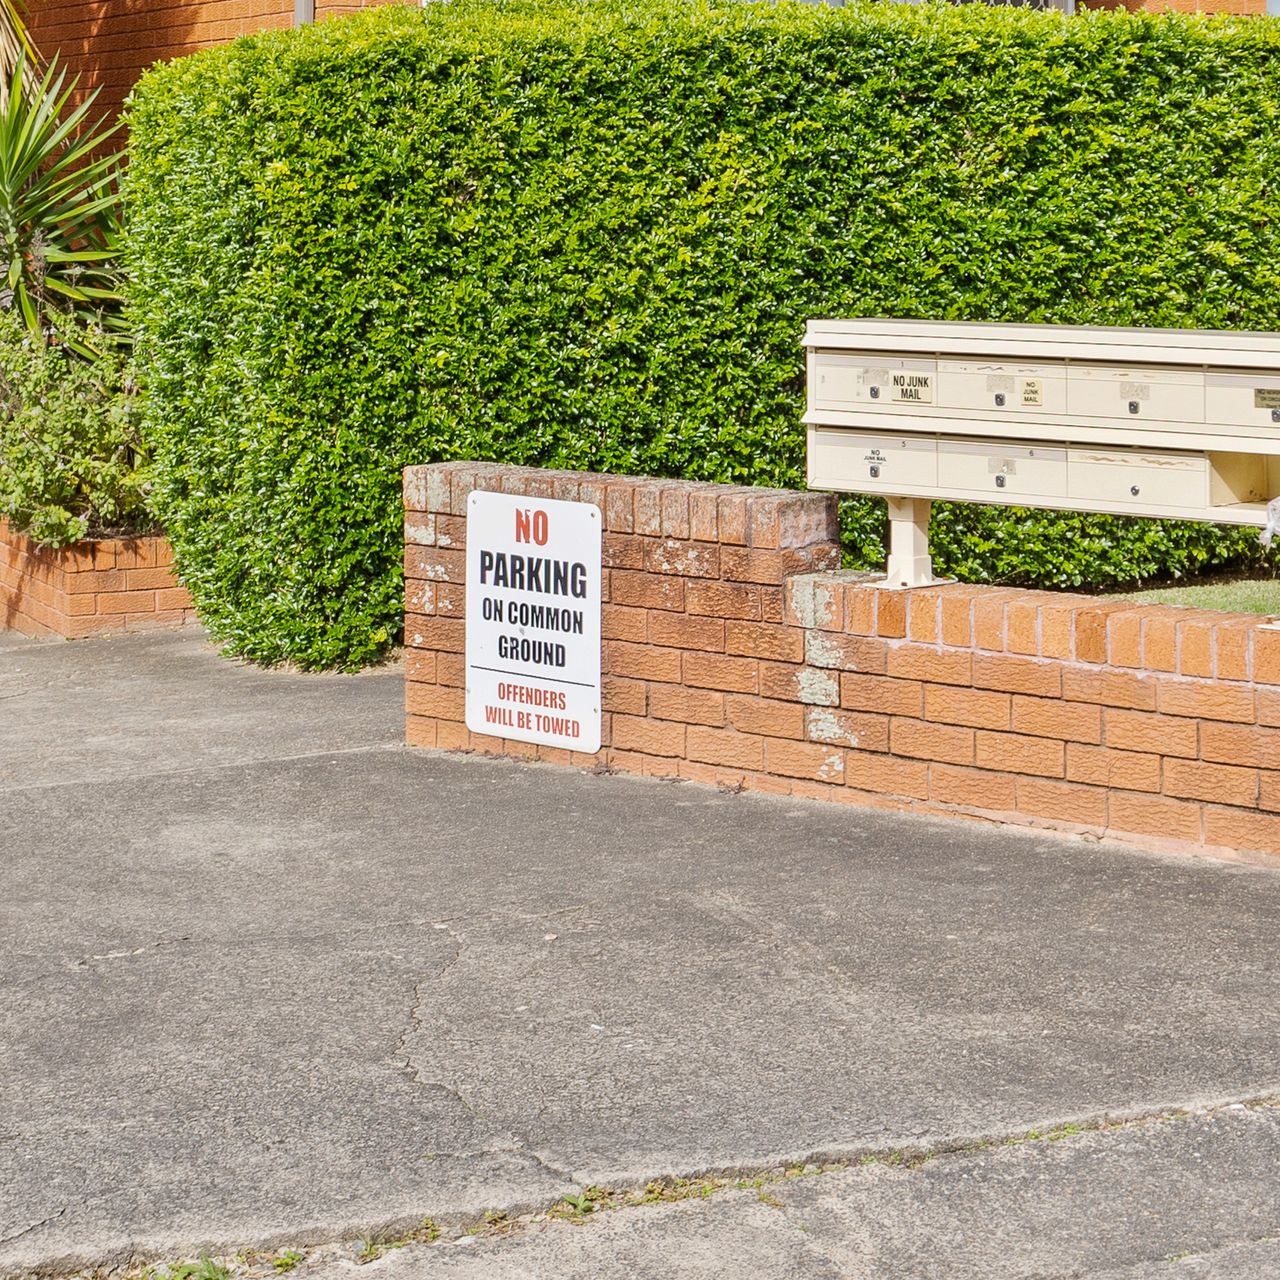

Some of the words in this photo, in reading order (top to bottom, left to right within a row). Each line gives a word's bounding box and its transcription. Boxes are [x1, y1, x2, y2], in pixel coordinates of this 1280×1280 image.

[893, 375, 905, 387] NO
[907, 376, 929, 388] JUNK
[901, 388, 921, 400] MAIL
[515, 508, 549, 546] NO
[480, 550, 587, 599] PARKING
[482, 597, 503, 623] ON
[508, 601, 583, 634] COMMON
[498, 634, 566, 668] GROUND
[497, 682, 566, 710] OFFENDERS
[485, 705, 514, 727] WILL
[517, 711, 532, 730] BE
[536, 714, 580, 738] TOWED
